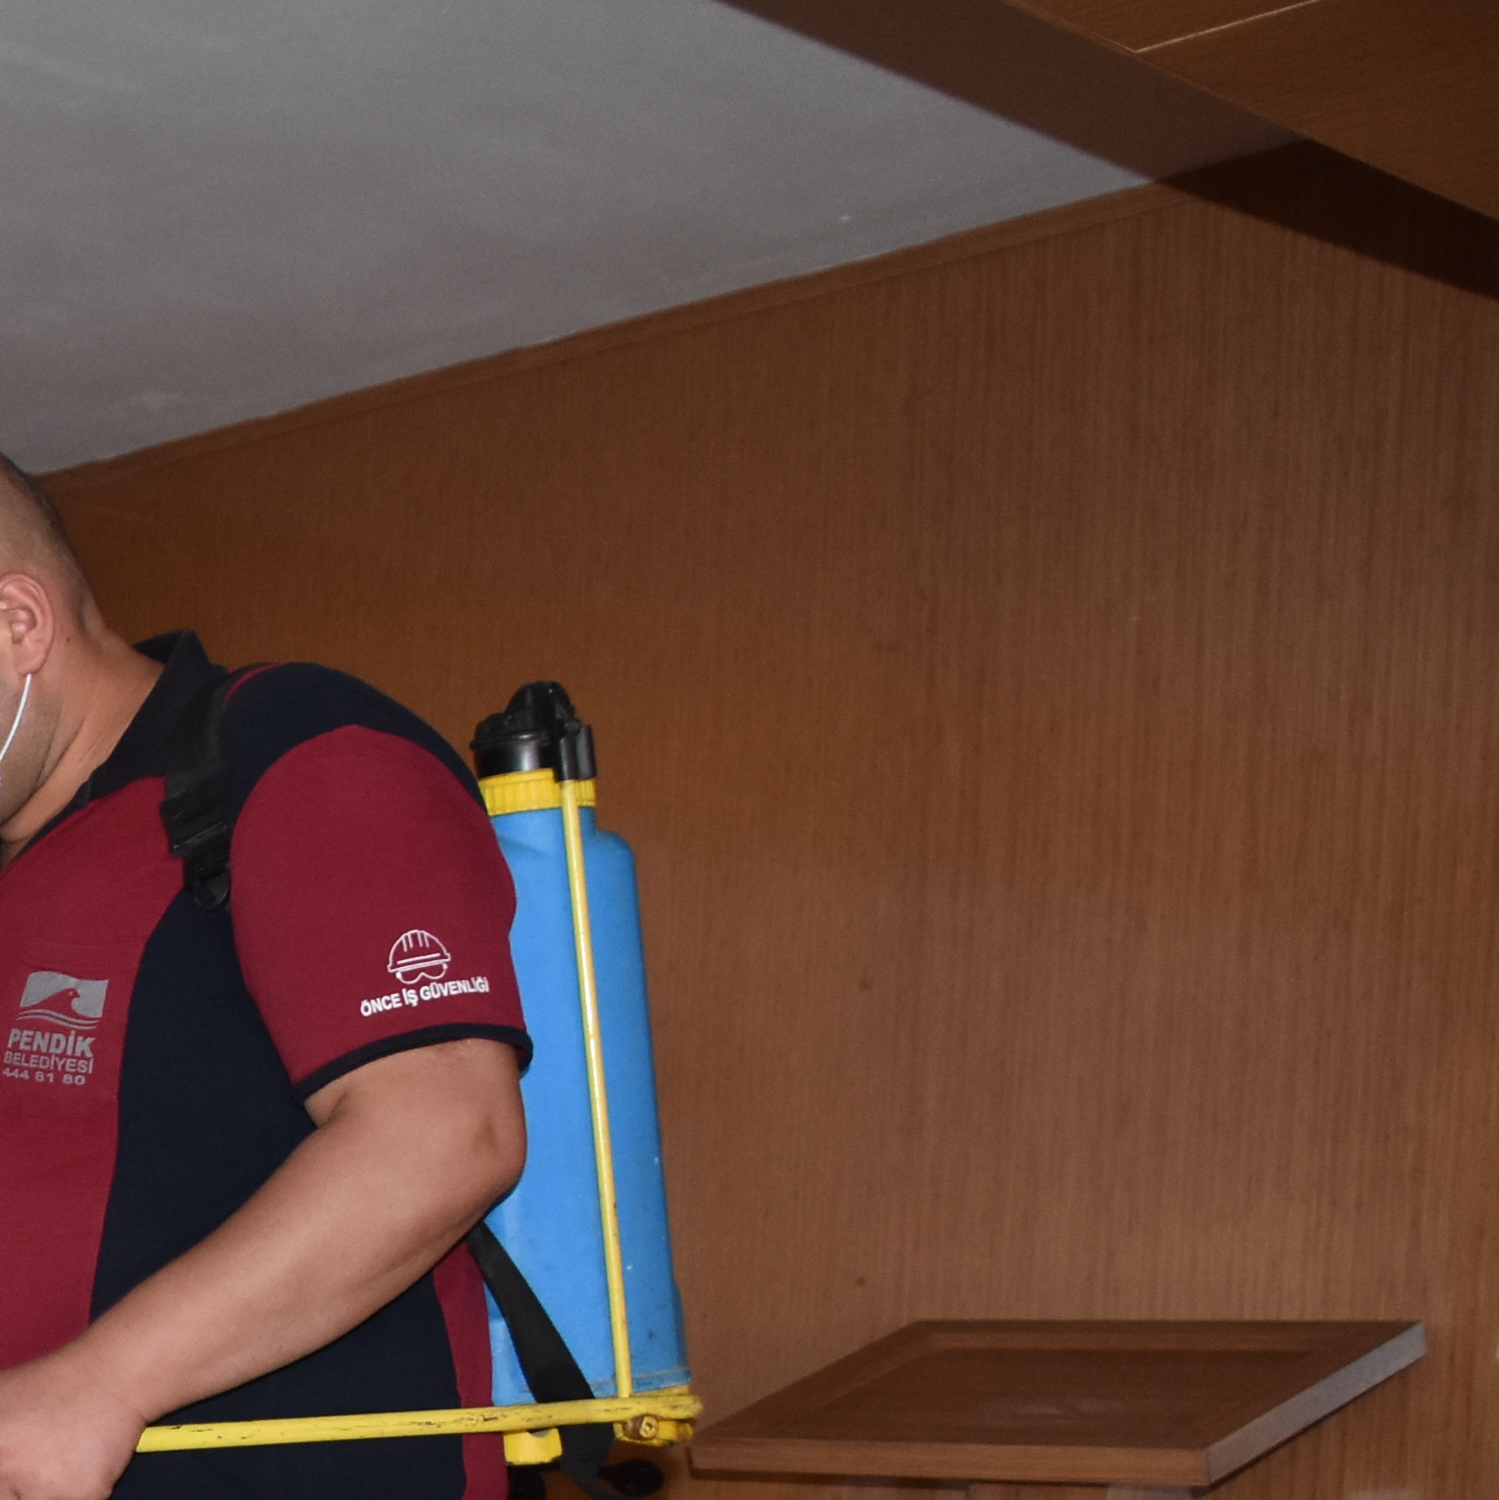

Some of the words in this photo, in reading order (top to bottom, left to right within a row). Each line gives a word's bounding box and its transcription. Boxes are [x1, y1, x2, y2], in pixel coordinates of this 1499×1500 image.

[360, 993, 402, 1017] ÖNCE
[401, 988, 419, 1007] İŞ
[8, 1029, 96, 1058] PENDİK
[2, 1067, 30, 1080] 444
[3, 1050, 94, 1074] BELEDİYESİ
